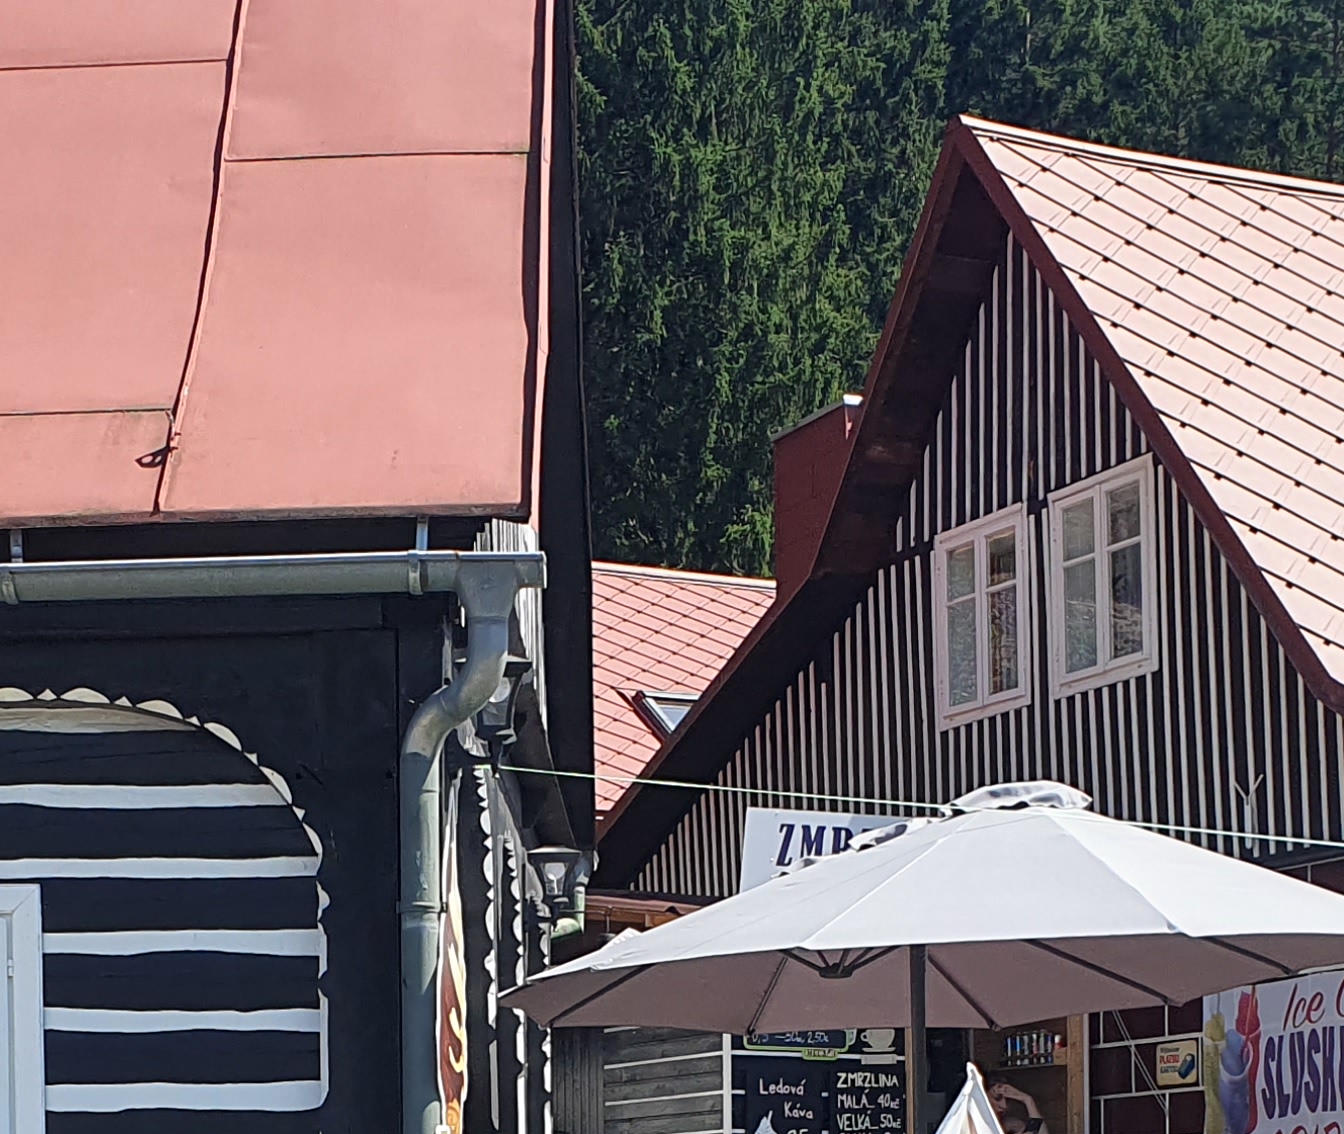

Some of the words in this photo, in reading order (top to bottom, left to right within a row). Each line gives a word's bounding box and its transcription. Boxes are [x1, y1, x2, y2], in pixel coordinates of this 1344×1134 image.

[775, 823, 873, 867] ZMR
[1282, 983, 1325, 1031] Ice
[759, 1078, 806, 1096] Ledová
[837, 1072, 899, 1088] ZMRZLINA
[784, 1101, 814, 1119] Káva
